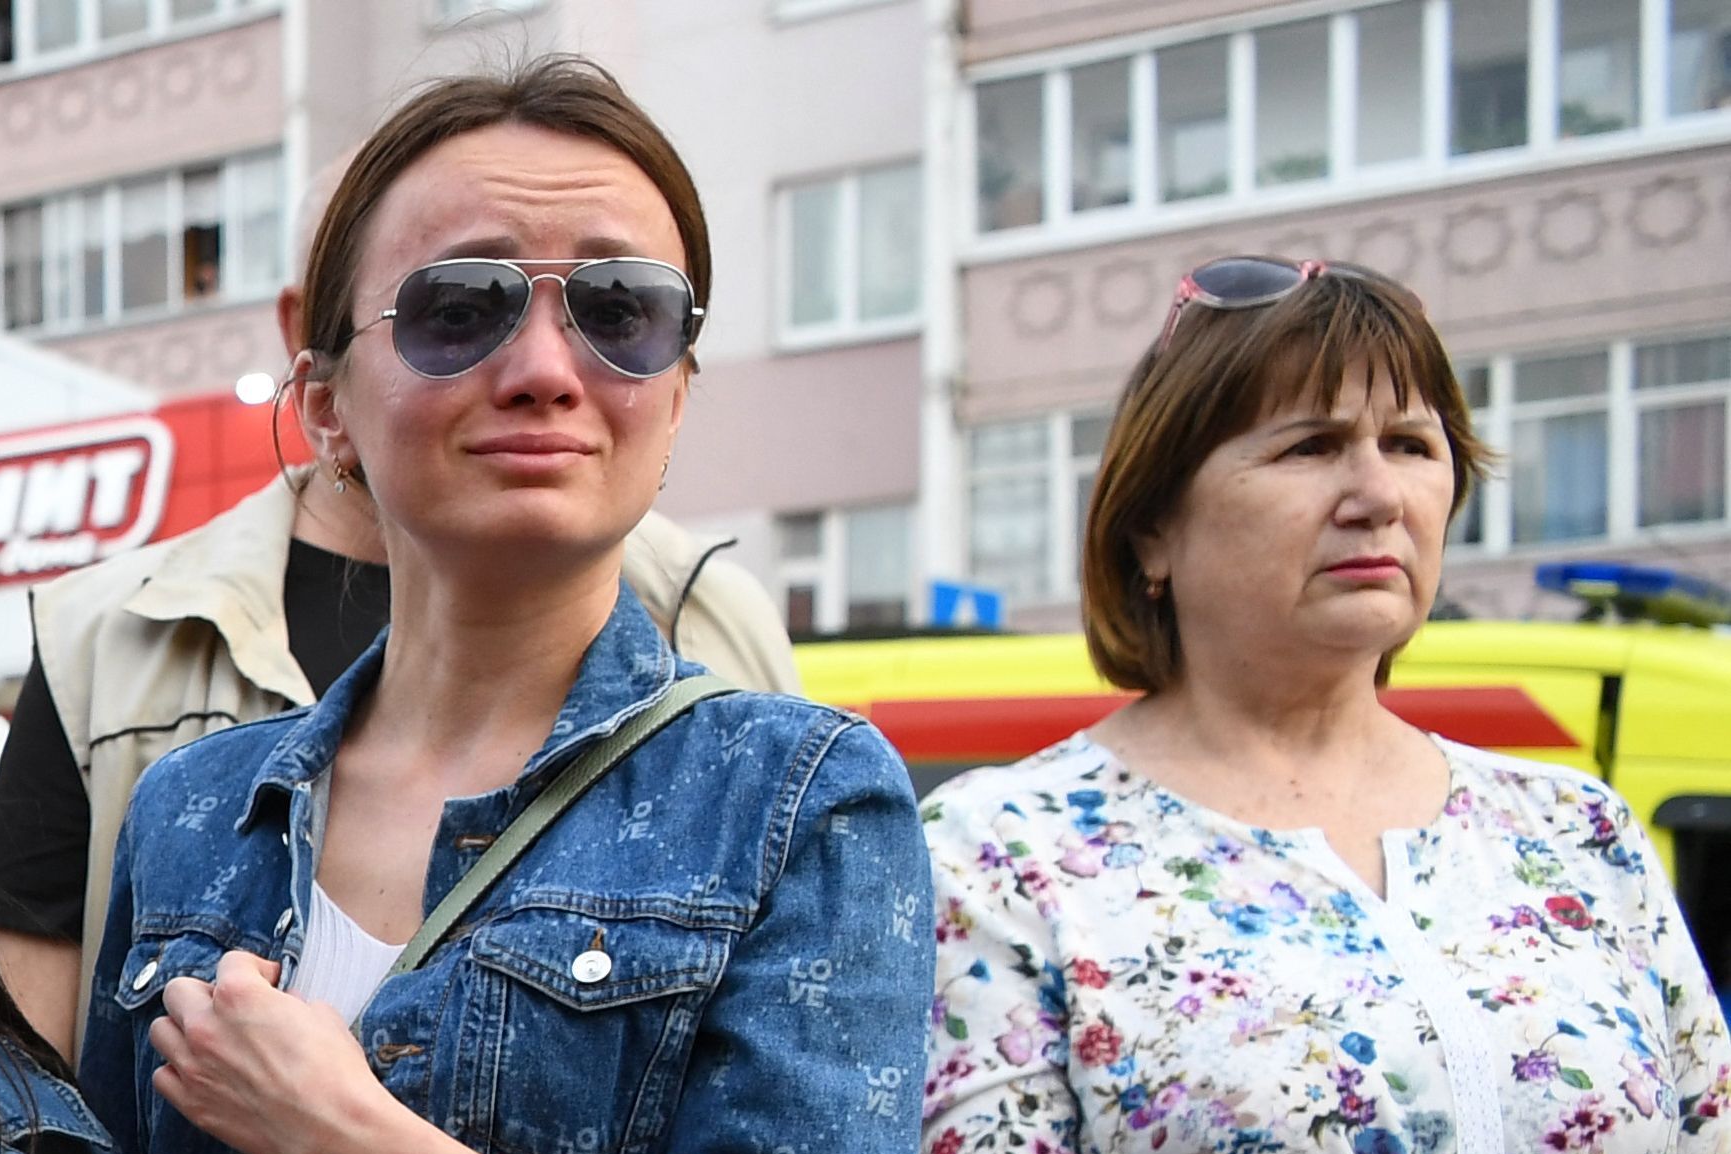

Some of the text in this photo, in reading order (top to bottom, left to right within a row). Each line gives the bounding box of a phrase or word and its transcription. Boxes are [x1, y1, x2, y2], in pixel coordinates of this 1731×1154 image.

[789, 957, 833, 983] LO
[787, 977, 830, 1009] VE
[863, 1065, 902, 1089] LO
[867, 1088, 898, 1117] VE
